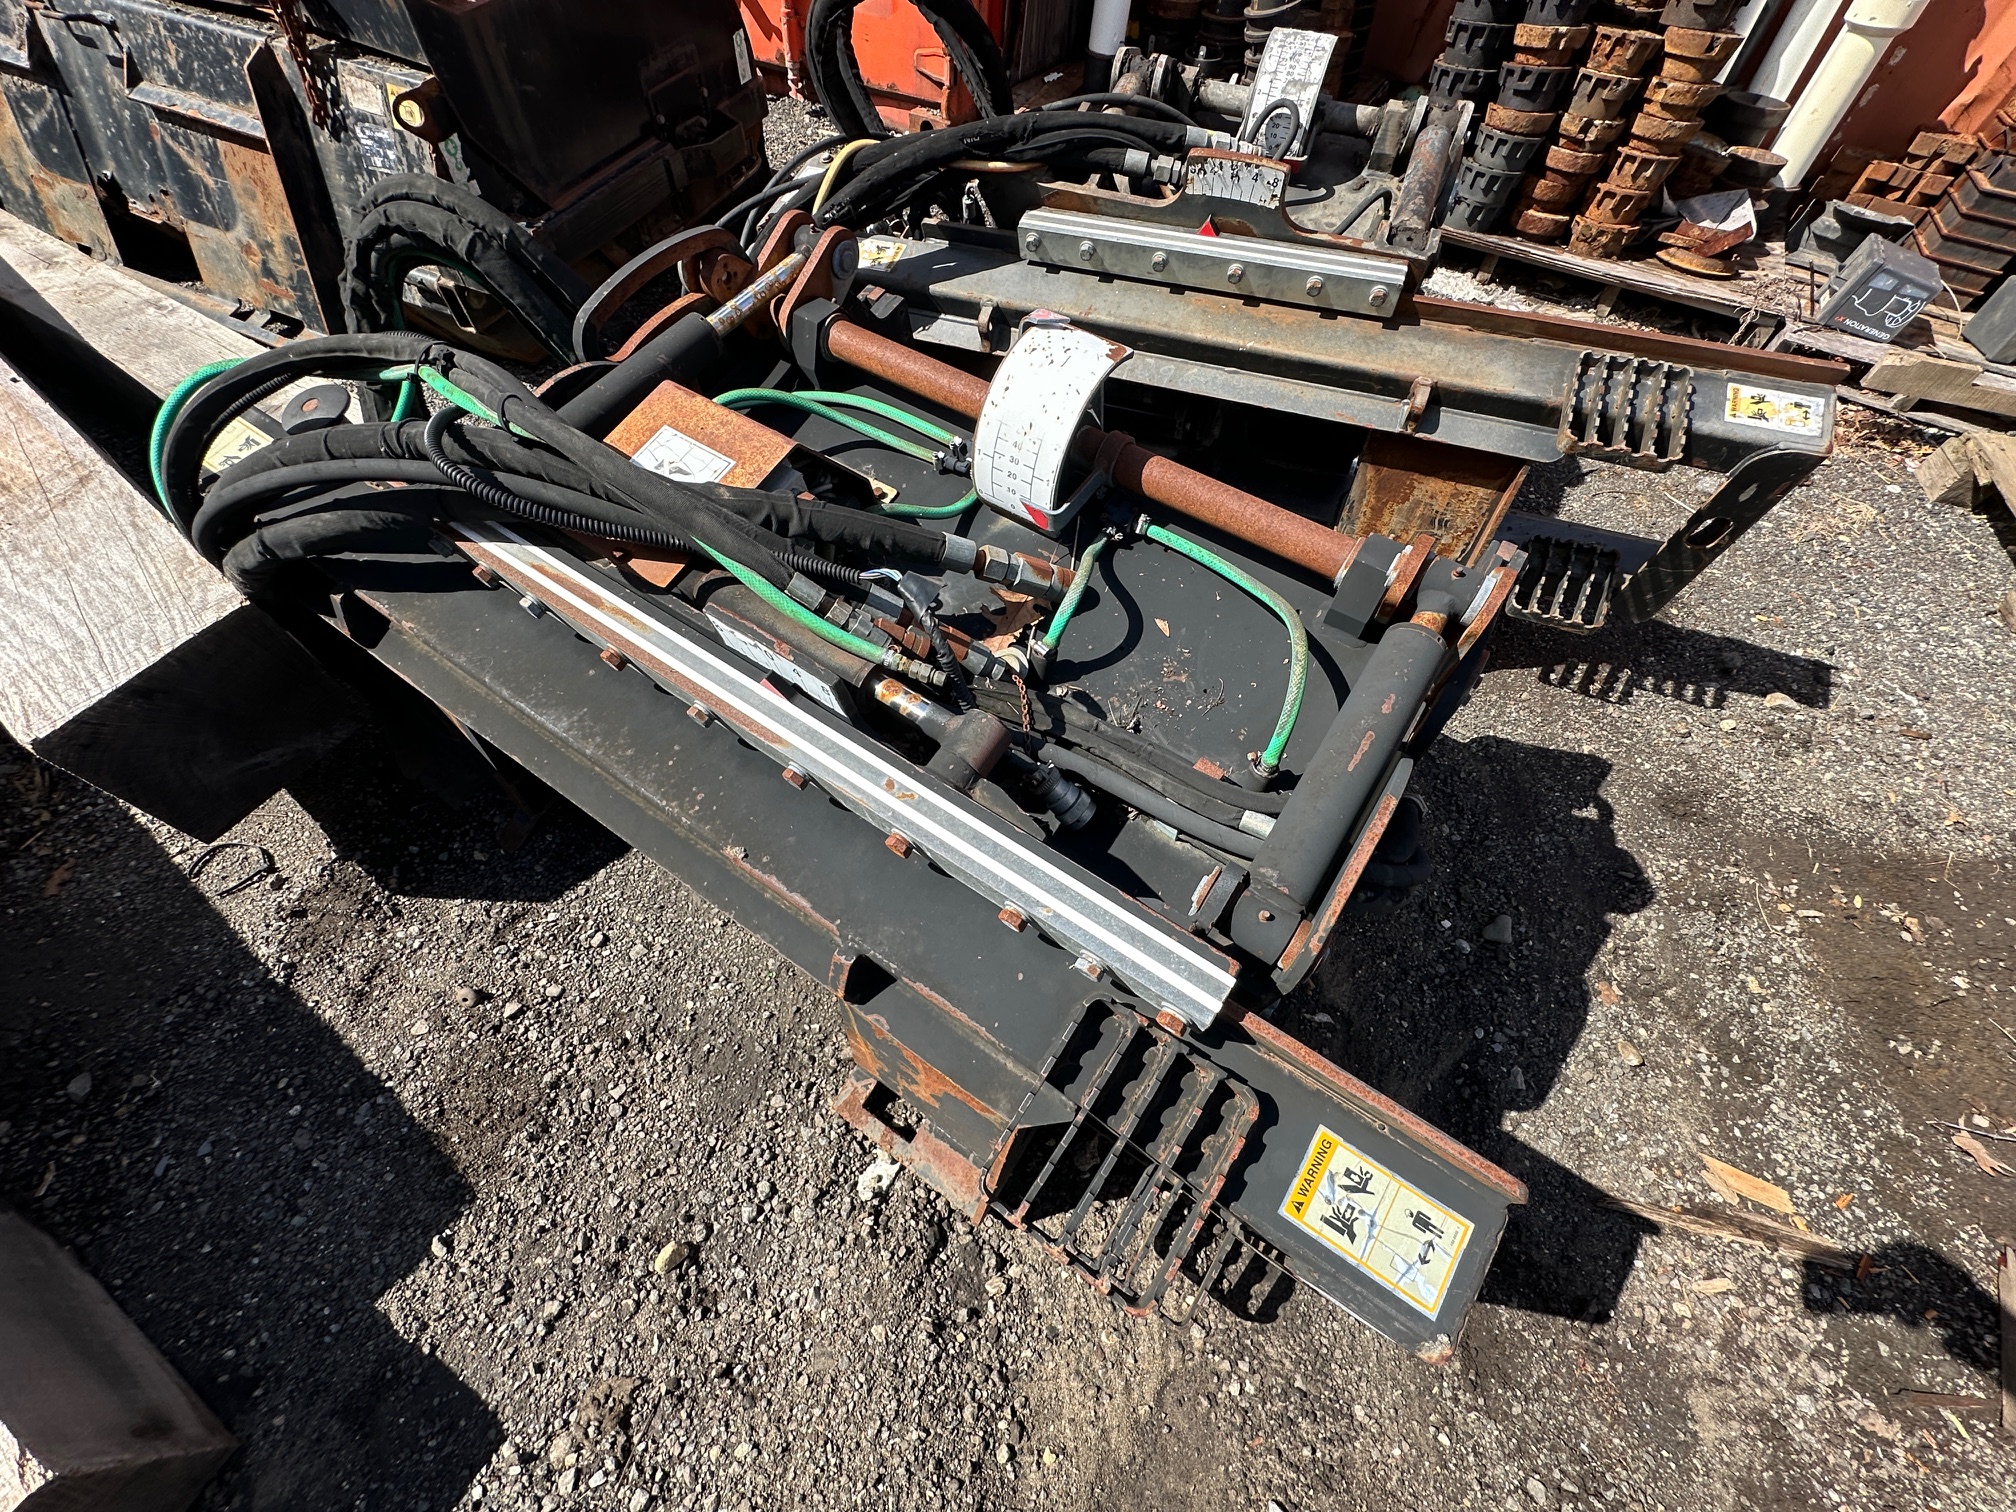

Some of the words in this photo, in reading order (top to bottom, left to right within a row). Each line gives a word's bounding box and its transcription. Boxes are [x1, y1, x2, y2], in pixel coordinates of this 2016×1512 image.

[1842, 318, 1891, 340] GENERATION
[1009, 455, 1020, 466] 30
[1007, 470, 1017, 481] 20
[1006, 486, 1017, 496] 10
[1297, 1138, 1333, 1198] WARNING
